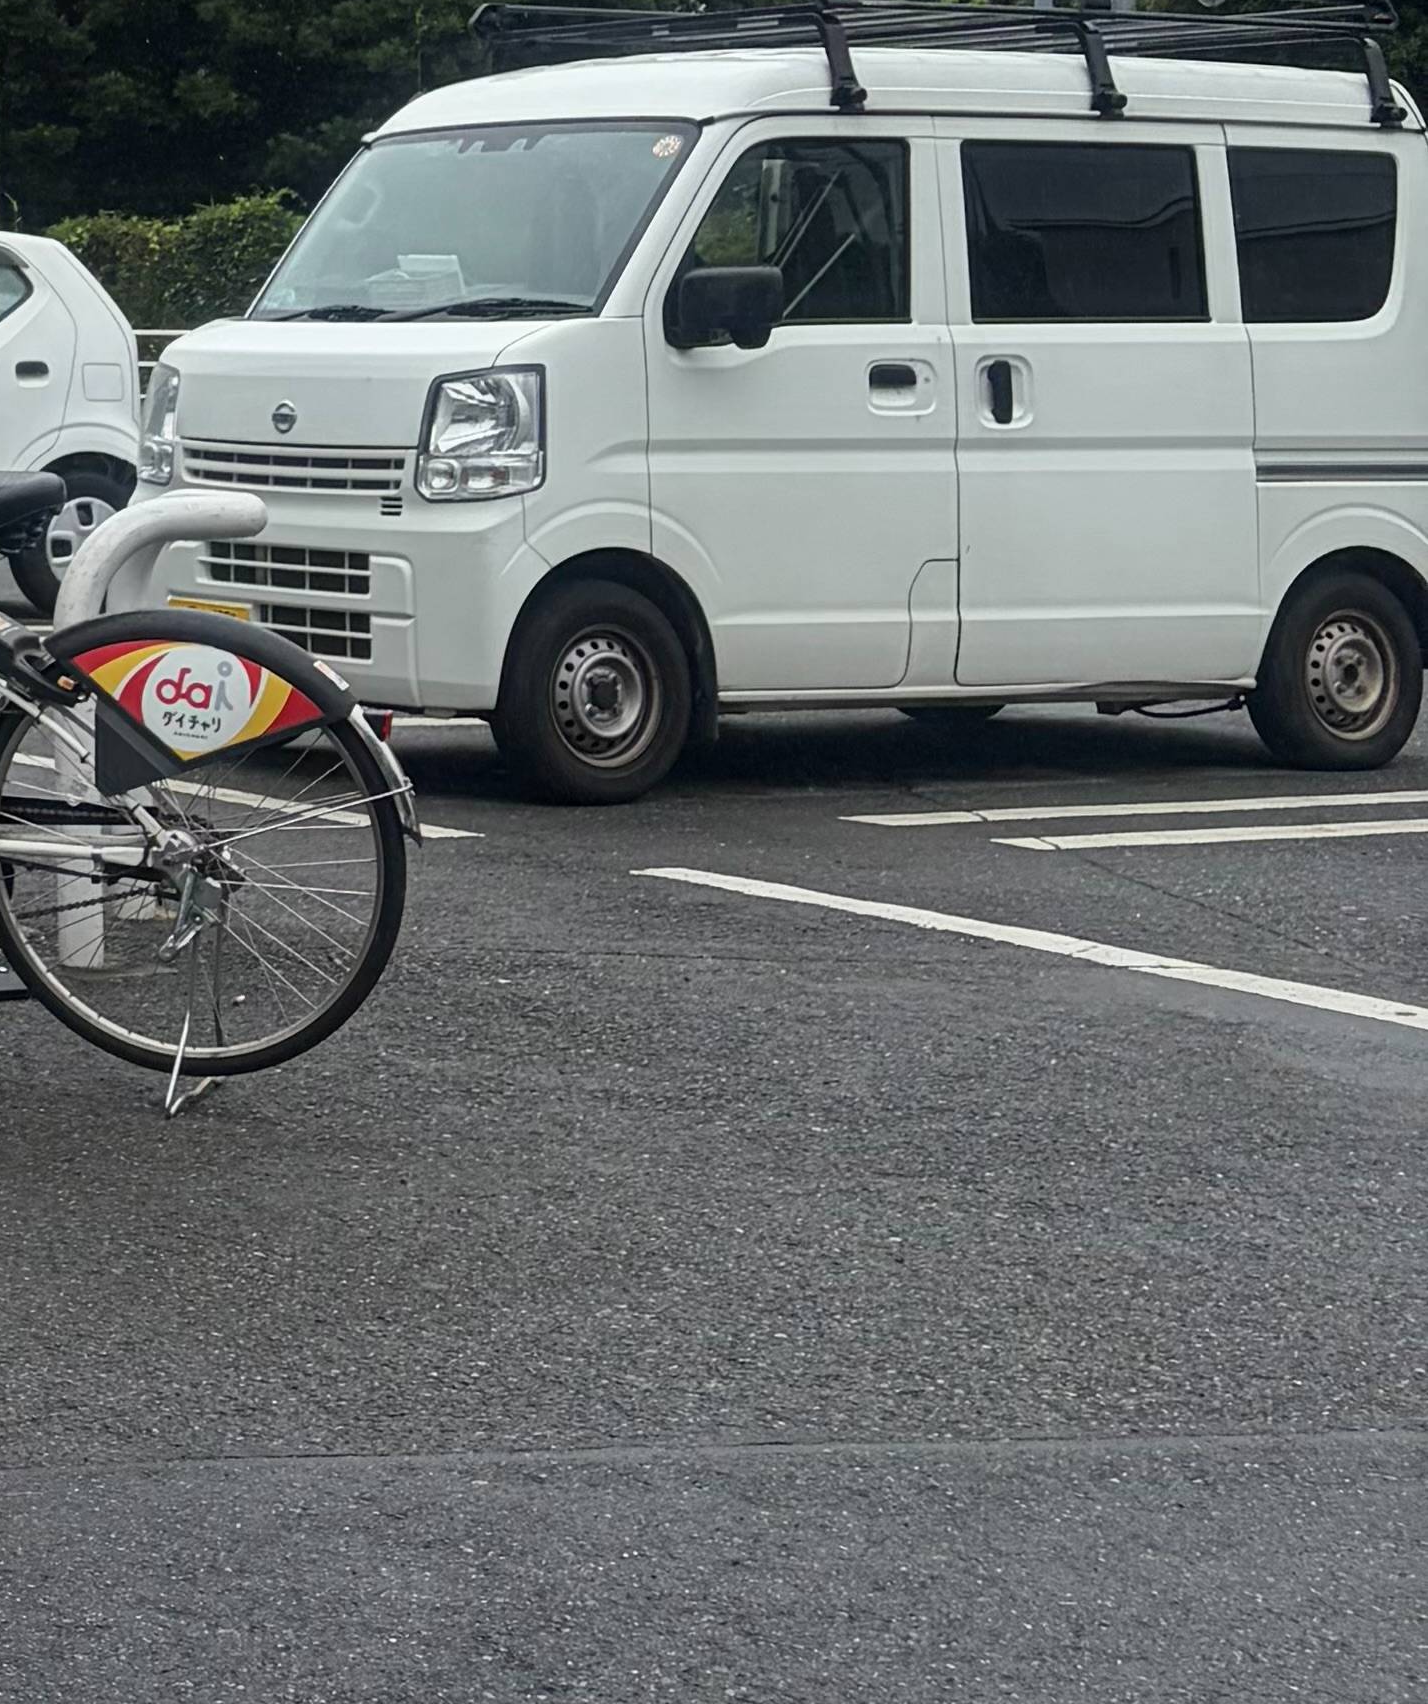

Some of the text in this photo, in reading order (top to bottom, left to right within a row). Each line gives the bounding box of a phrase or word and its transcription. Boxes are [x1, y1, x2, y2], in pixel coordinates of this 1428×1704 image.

[156, 661, 234, 712] dai
[162, 711, 222, 734] ダイチャリ
